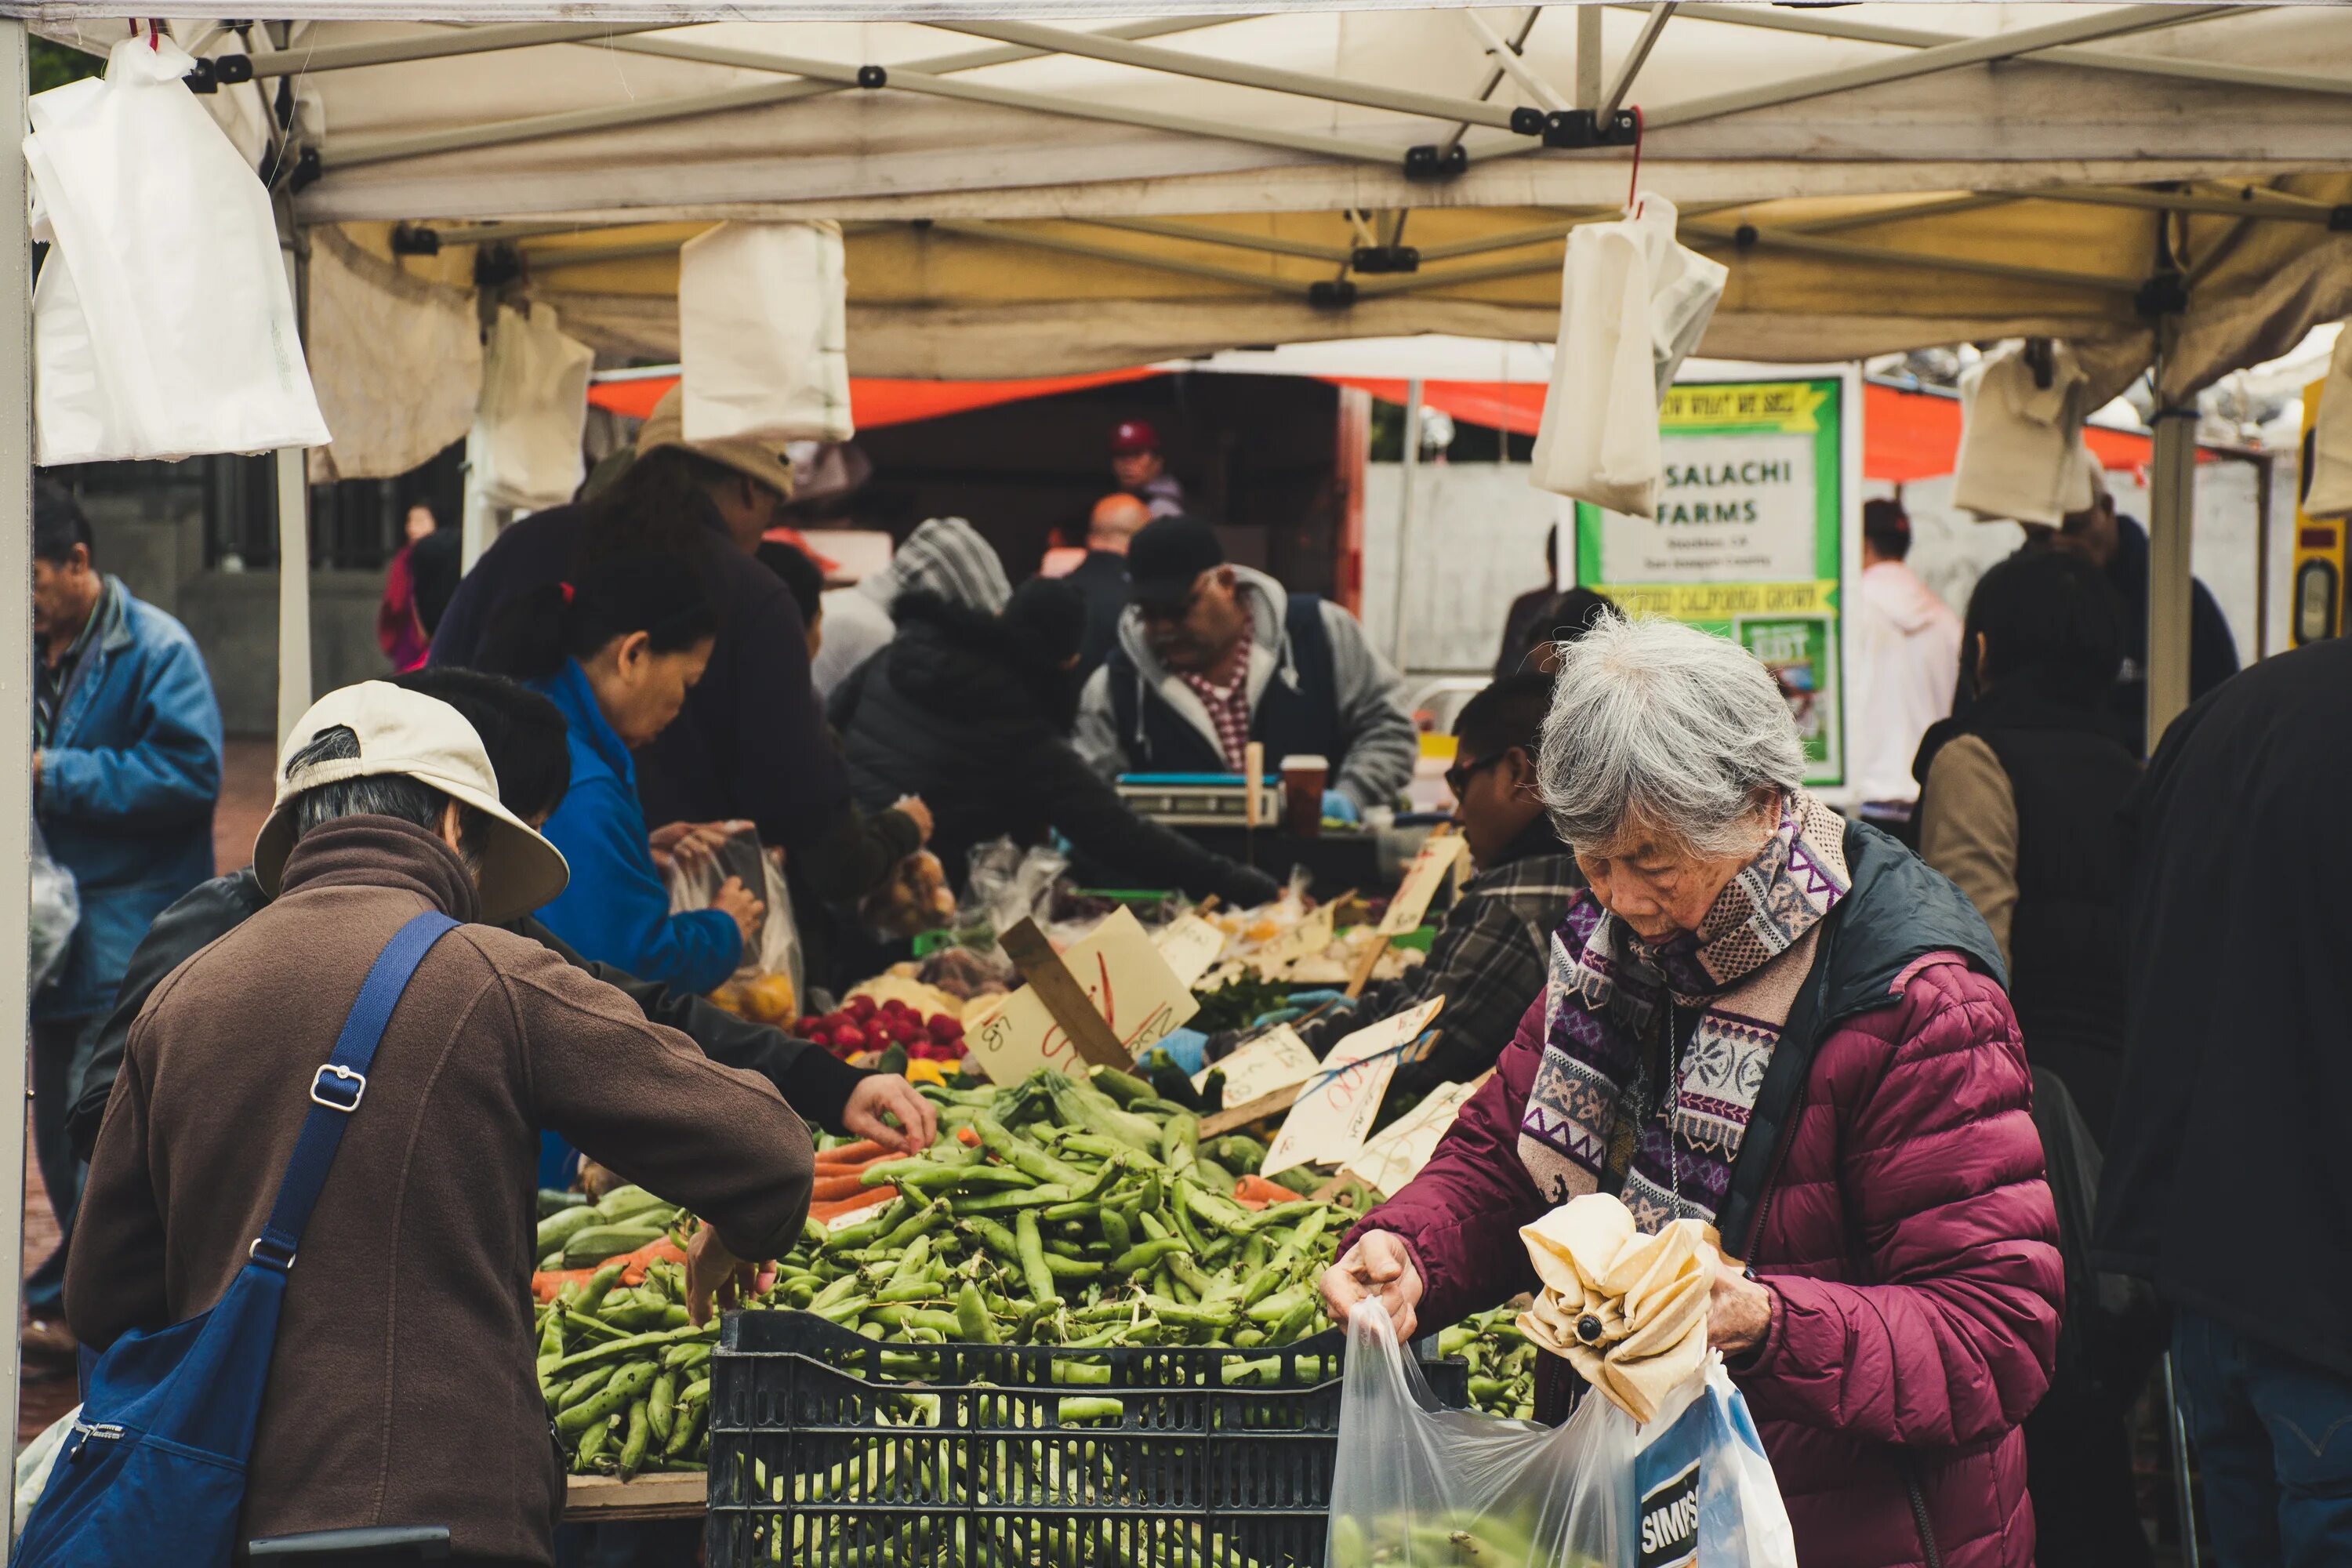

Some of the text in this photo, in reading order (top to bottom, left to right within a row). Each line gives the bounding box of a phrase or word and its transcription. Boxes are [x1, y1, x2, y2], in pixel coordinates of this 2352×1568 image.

[1691, 394, 1731, 415] WHAT
[1737, 394, 1756, 414] WE
[1657, 500, 1758, 525] FARMS
[1679, 588, 1757, 611] CALIFORNIA
[1766, 586, 1816, 610] GROWN
[1642, 1486, 1698, 1554] SIMPS
